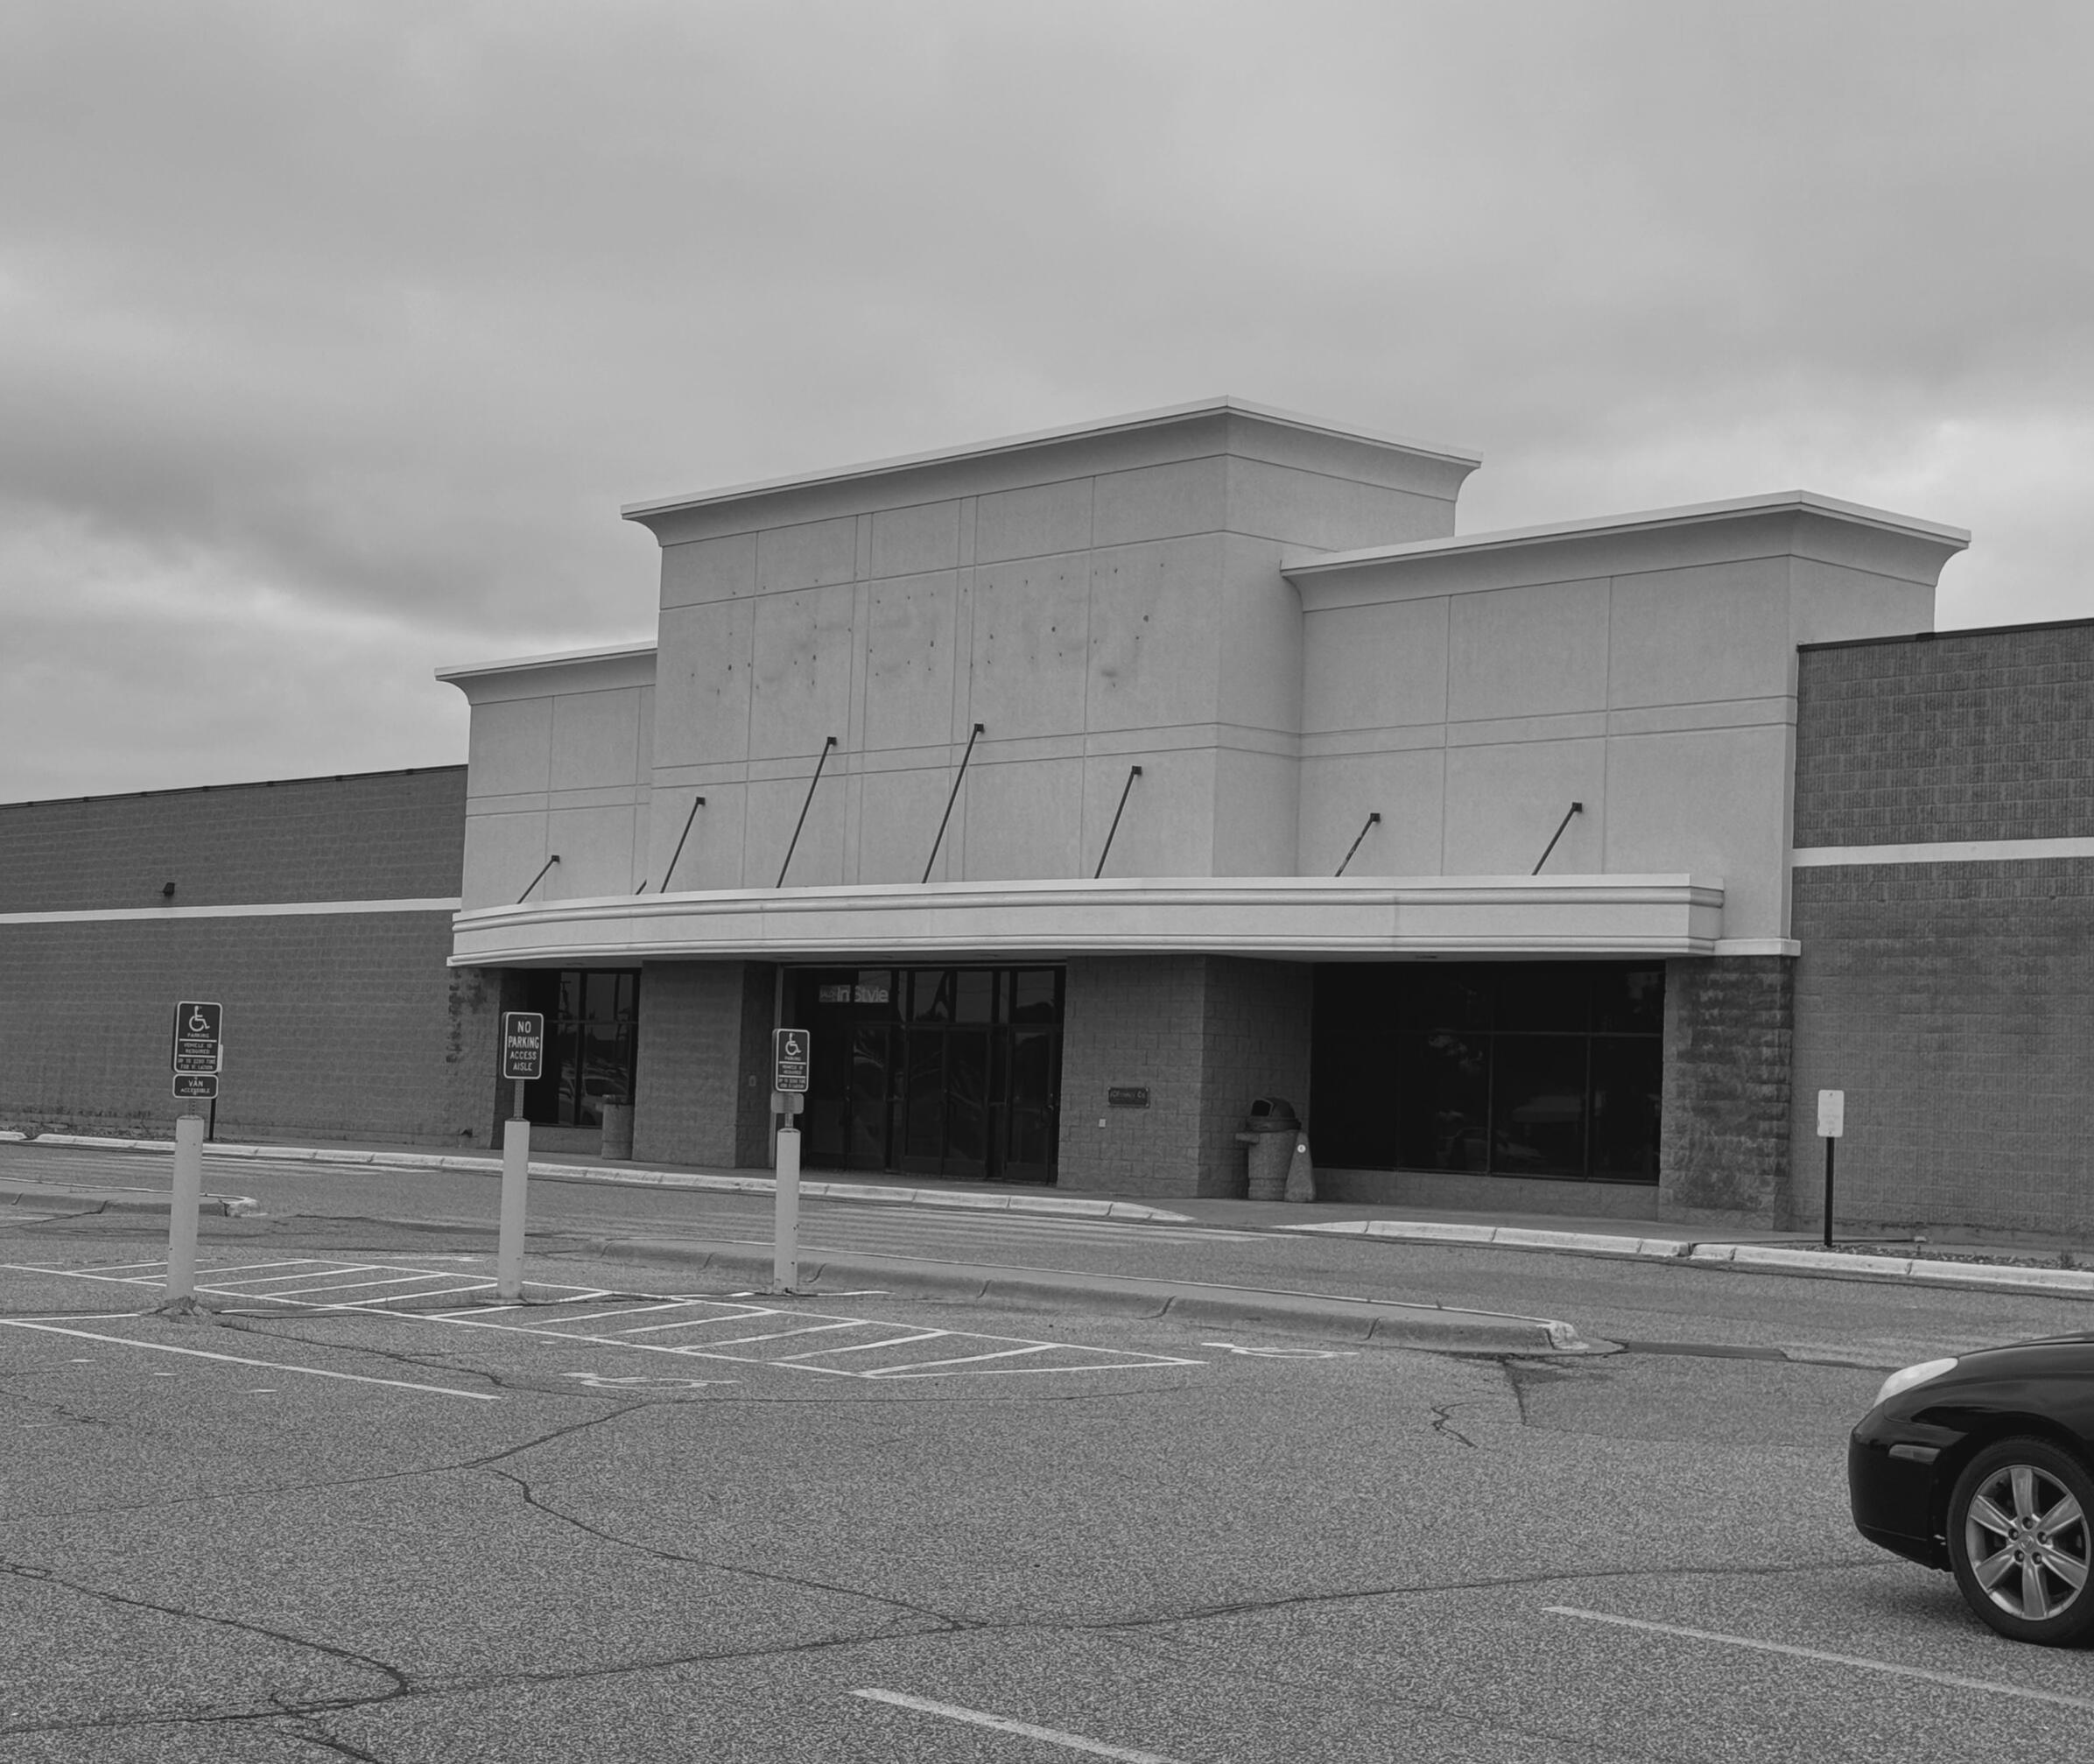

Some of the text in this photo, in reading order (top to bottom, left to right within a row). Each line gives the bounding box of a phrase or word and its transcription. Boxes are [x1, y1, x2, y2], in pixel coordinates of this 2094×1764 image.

[517, 1021, 531, 1033] NO
[508, 1036, 539, 1049] PARKING
[509, 1051, 537, 1060] ACCESS
[513, 1062, 532, 1071] AISLE
